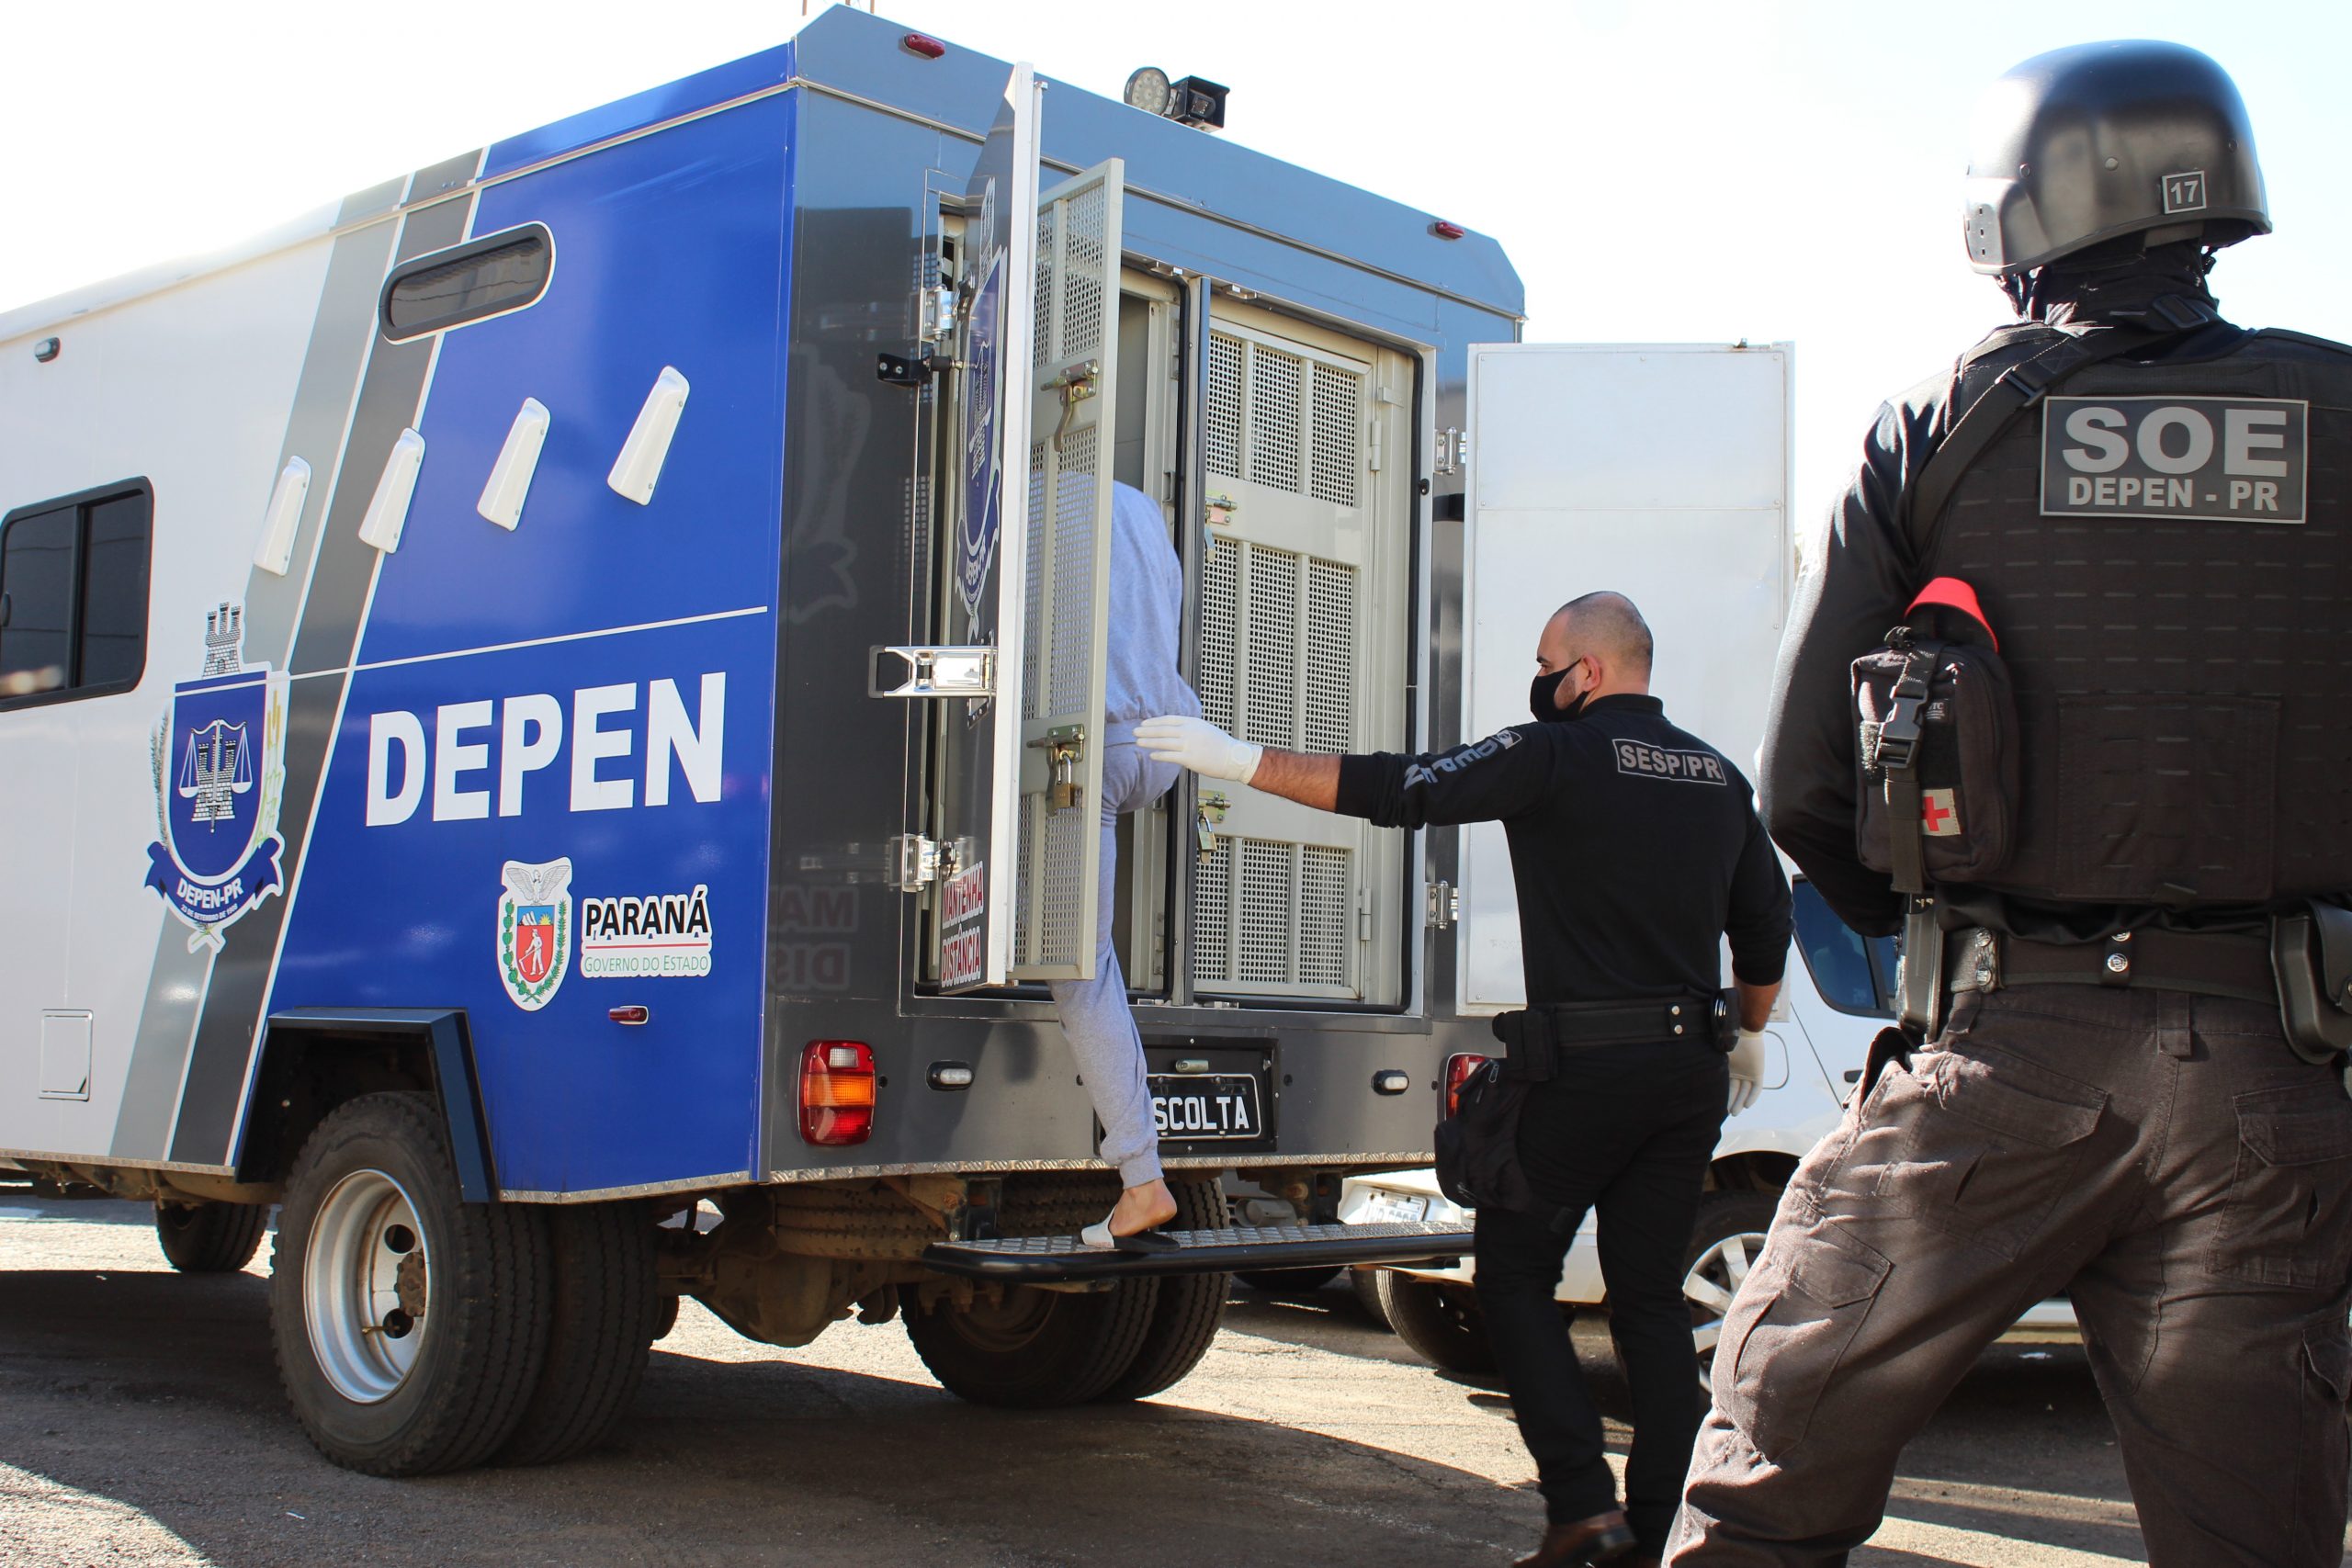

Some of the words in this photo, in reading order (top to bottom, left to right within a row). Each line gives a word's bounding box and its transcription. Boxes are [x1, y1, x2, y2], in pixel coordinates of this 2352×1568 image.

[2170, 180, 2199, 205] 17
[2062, 406, 2288, 478] SOE
[2067, 476, 2193, 508] DEPEN
[2229, 480, 2279, 512] PR
[366, 671, 727, 828] DEPEN
[1620, 744, 1724, 780] SESP/PR
[175, 877, 244, 909] DEPEN-PR
[943, 864, 983, 923] MANTENHA
[585, 890, 709, 937] PARANÁ
[584, 956, 639, 973] GOVERNO
[643, 956, 660, 971] DO
[663, 954, 708, 971] ESTADO
[942, 927, 981, 984] DISTÂNCIA
[1151, 1096, 1250, 1131] SCOLTA
